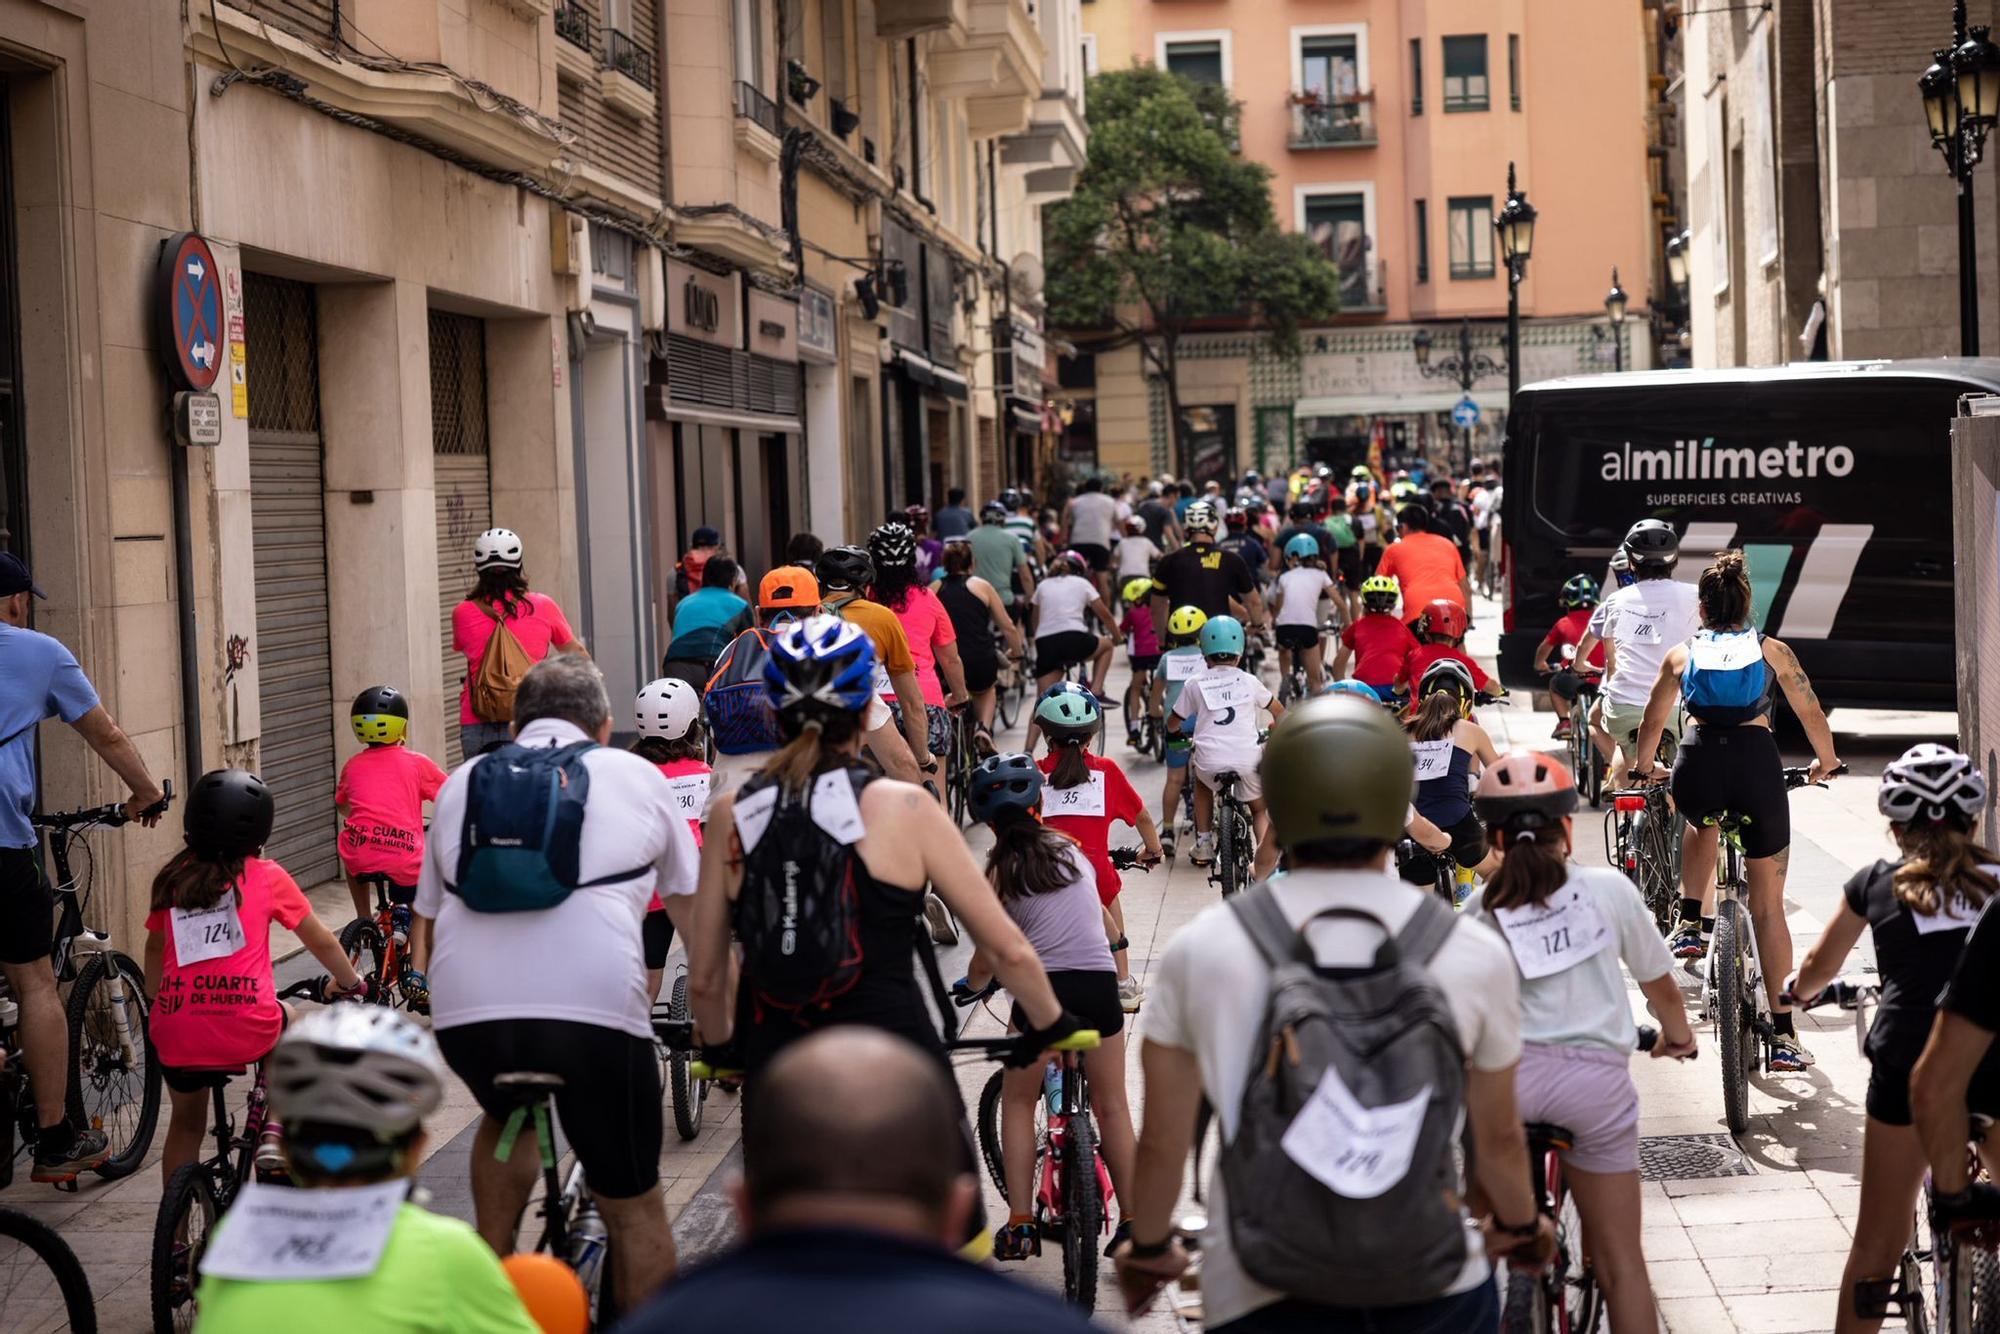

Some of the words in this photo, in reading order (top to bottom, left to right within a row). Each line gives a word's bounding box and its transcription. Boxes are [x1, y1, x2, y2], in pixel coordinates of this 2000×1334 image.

[1601, 437, 1855, 481] almilímetro
[1646, 493, 1726, 506] SUPERFICIES
[1730, 491, 1802, 505] CREATIVAS
[1417, 758, 1435, 771] 34
[1061, 791, 1079, 805] 35
[370, 836, 382, 846] DE
[372, 825, 415, 845] CUARTE
[204, 921, 231, 945] 124
[193, 974, 259, 992] CUARTE
[189, 992, 208, 1005] DE
[209, 993, 258, 1006] HUERVA
